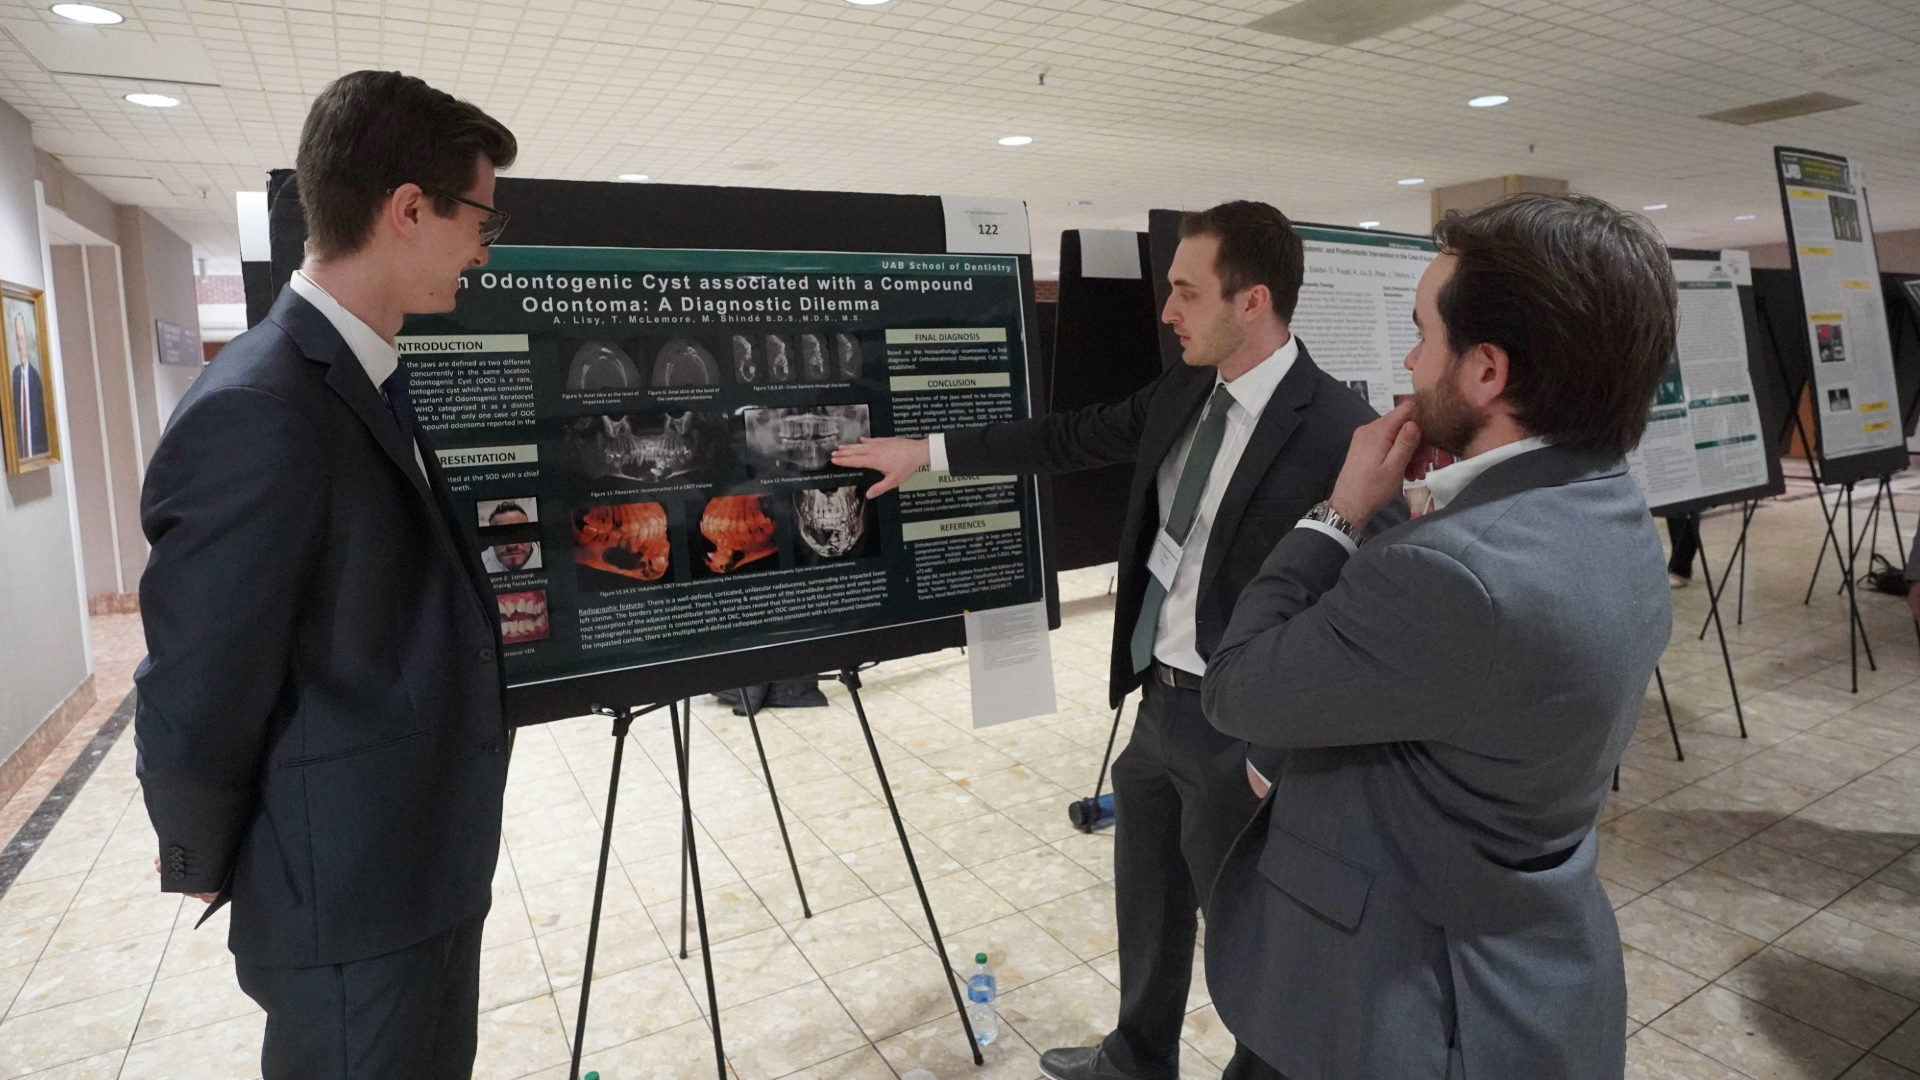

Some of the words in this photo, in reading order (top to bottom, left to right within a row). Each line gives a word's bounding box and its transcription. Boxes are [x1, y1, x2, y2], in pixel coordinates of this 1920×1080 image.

[978, 224, 999, 235] 122
[882, 261, 904, 269] UAB
[909, 261, 945, 270] School
[950, 262, 960, 270] of
[965, 262, 1011, 273] Dentistry
[480, 273, 633, 293] Odontogenic
[642, 274, 691, 293] Cyst
[700, 275, 808, 290] associated
[817, 276, 856, 290] with
[864, 279, 873, 291] a
[881, 277, 973, 293] Compound
[522, 296, 648, 313] Odontoma:
[658, 296, 672, 312] A
[681, 297, 791, 314] Diagnostic
[800, 297, 880, 311] Dilemma
[553, 316, 566, 324] A.
[573, 316, 605, 326] Lisy,
[629, 315, 696, 324] McLemore,
[702, 315, 714, 323] M.
[915, 334, 937, 342] FINAL
[939, 333, 980, 341] DIAGNOSIS
[398, 341, 483, 352] NTRODUCTION
[420, 361, 436, 369] jaws
[928, 379, 976, 388] CONCLUSION
[446, 387, 460, 395] cyst
[438, 404, 476, 413] categorized
[461, 412, 476, 420] only
[487, 419, 515, 427] reported
[440, 452, 516, 466] RESENTATION
[523, 470, 539, 478] chief
[940, 520, 986, 532] REFERENCES
[578, 605, 618, 616] Radiographic
[619, 602, 646, 610] features:
[647, 599, 664, 607] There
[677, 593, 713, 603] well-defined,
[808, 576, 838, 586] surrounding
[629, 609, 652, 618] borders
[595, 622, 626, 631] resorption
[646, 614, 671, 624] adjacent
[671, 610, 704, 620] mandibular
[594, 629, 632, 640] radiographic
[633, 624, 667, 634] appearance
[674, 618, 704, 628] consistent
[593, 638, 622, 649] impacted
[622, 636, 645, 644] canine,
[645, 633, 661, 641] there
[672, 627, 696, 637] multiple
